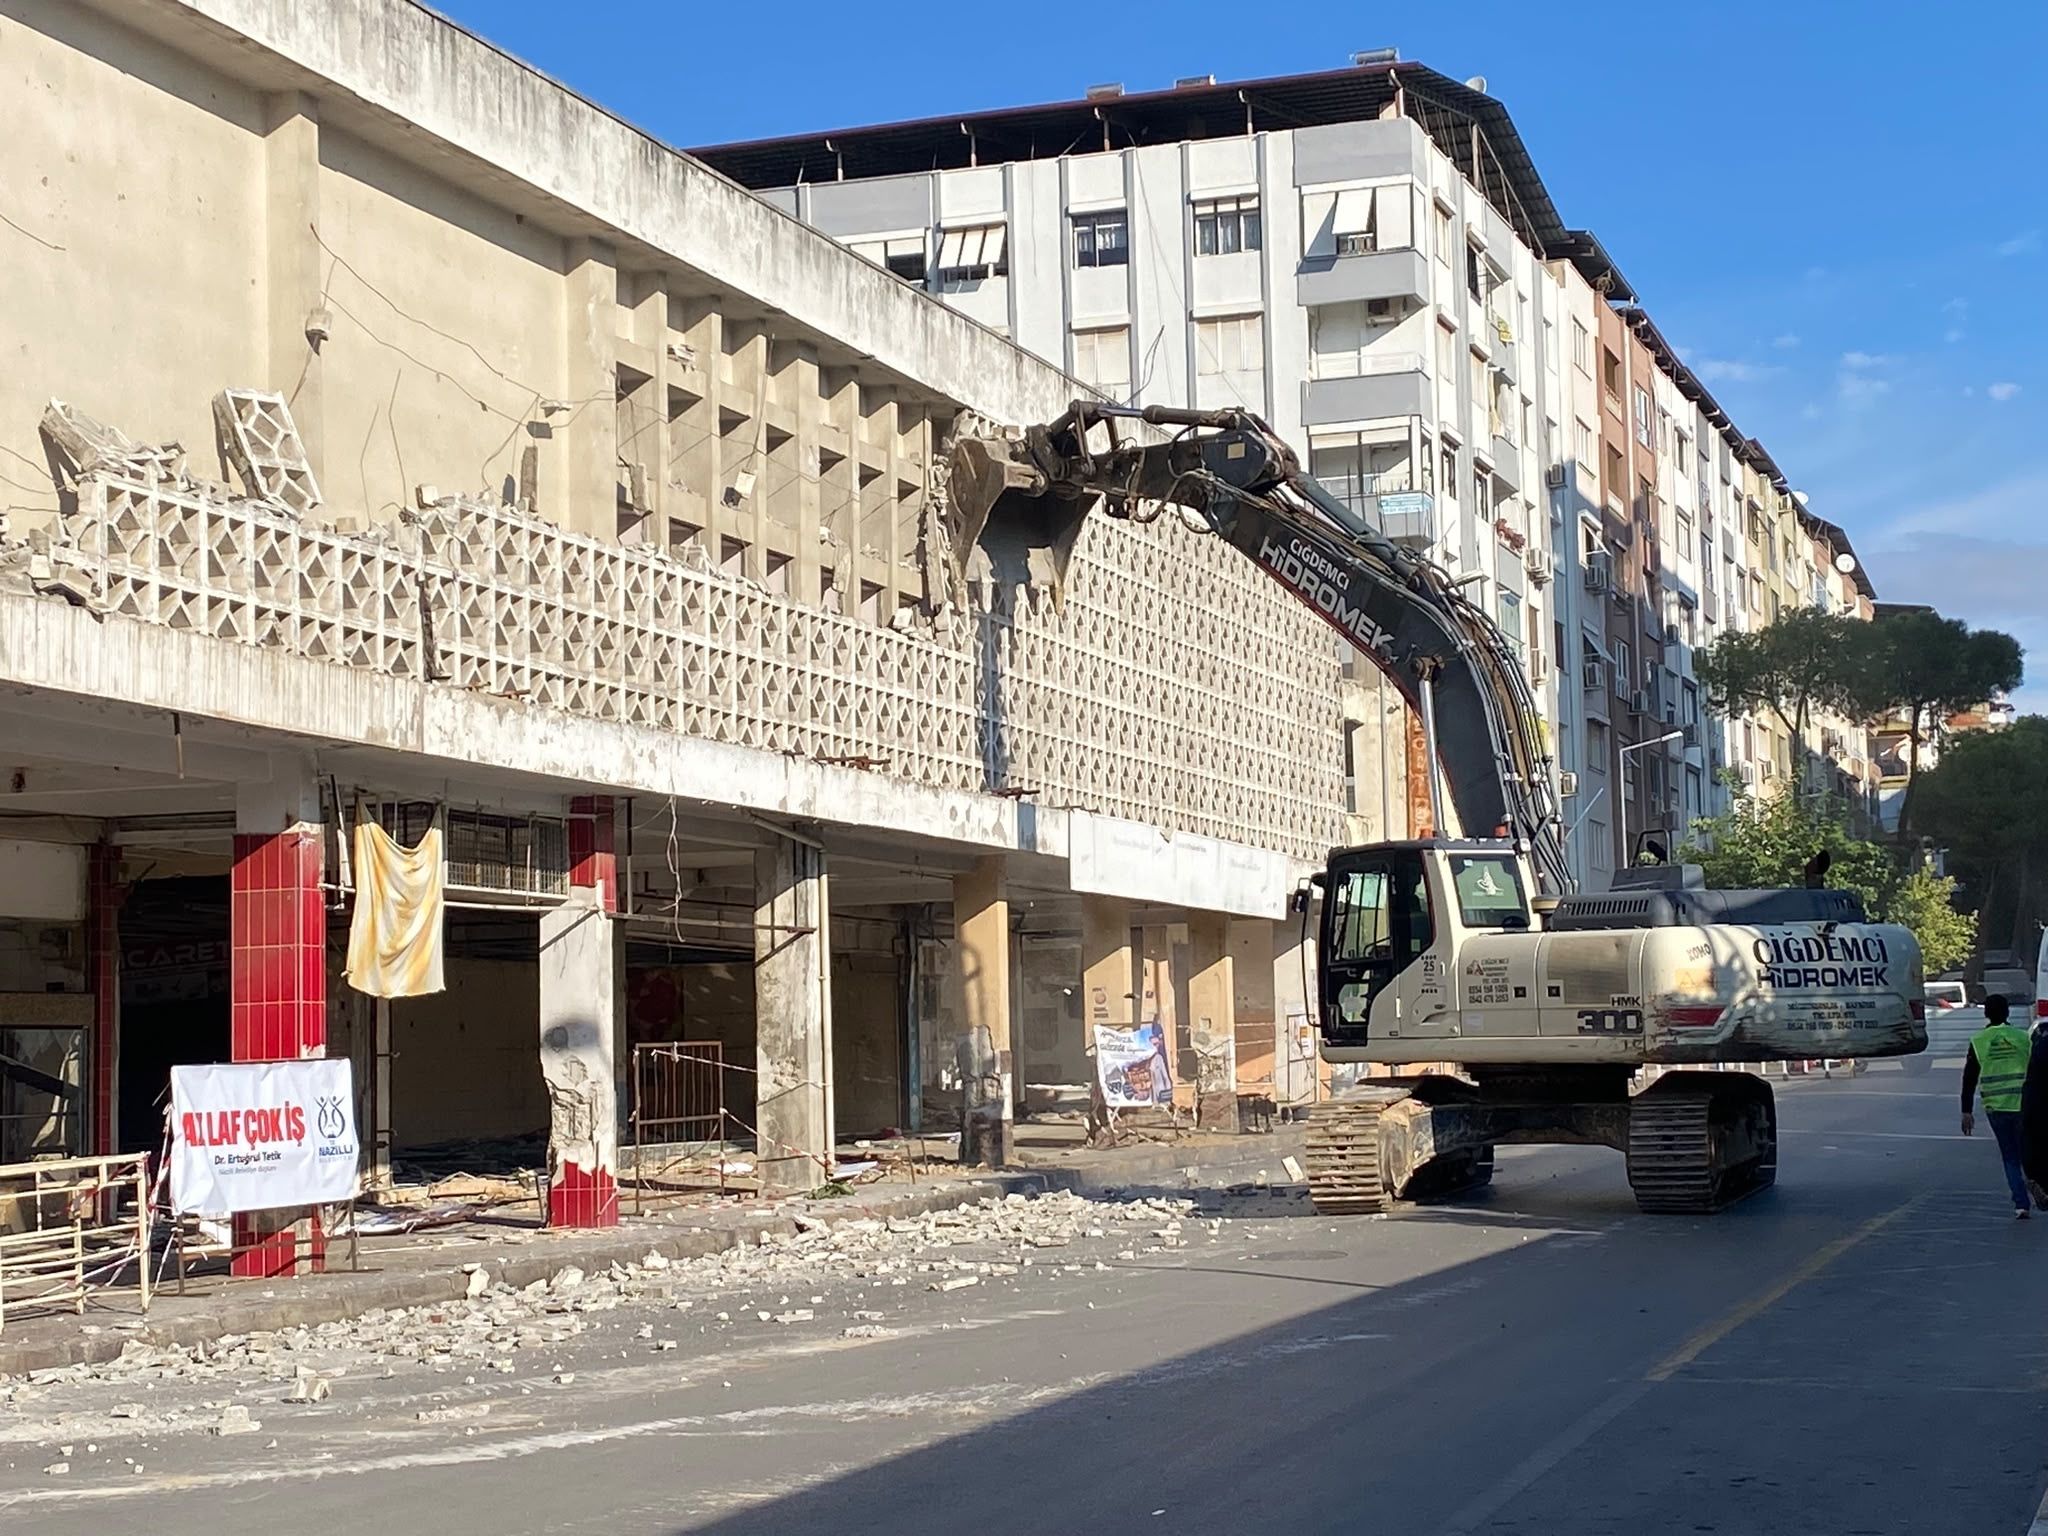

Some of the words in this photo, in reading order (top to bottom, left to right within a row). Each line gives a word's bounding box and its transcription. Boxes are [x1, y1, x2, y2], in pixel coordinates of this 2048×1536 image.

[1753, 931, 1888, 966] ÇİĞDEMCİ
[1424, 961, 1434, 972] 25
[1611, 996, 1641, 1007] HMK
[1577, 1009, 1643, 1034] 300
[207, 1110, 241, 1147] LAF
[244, 1107, 284, 1151] ÇOK
[284, 1100, 306, 1148] İŞ
[215, 1155, 226, 1165] Dr.
[263, 1151, 281, 1161] Tetik
